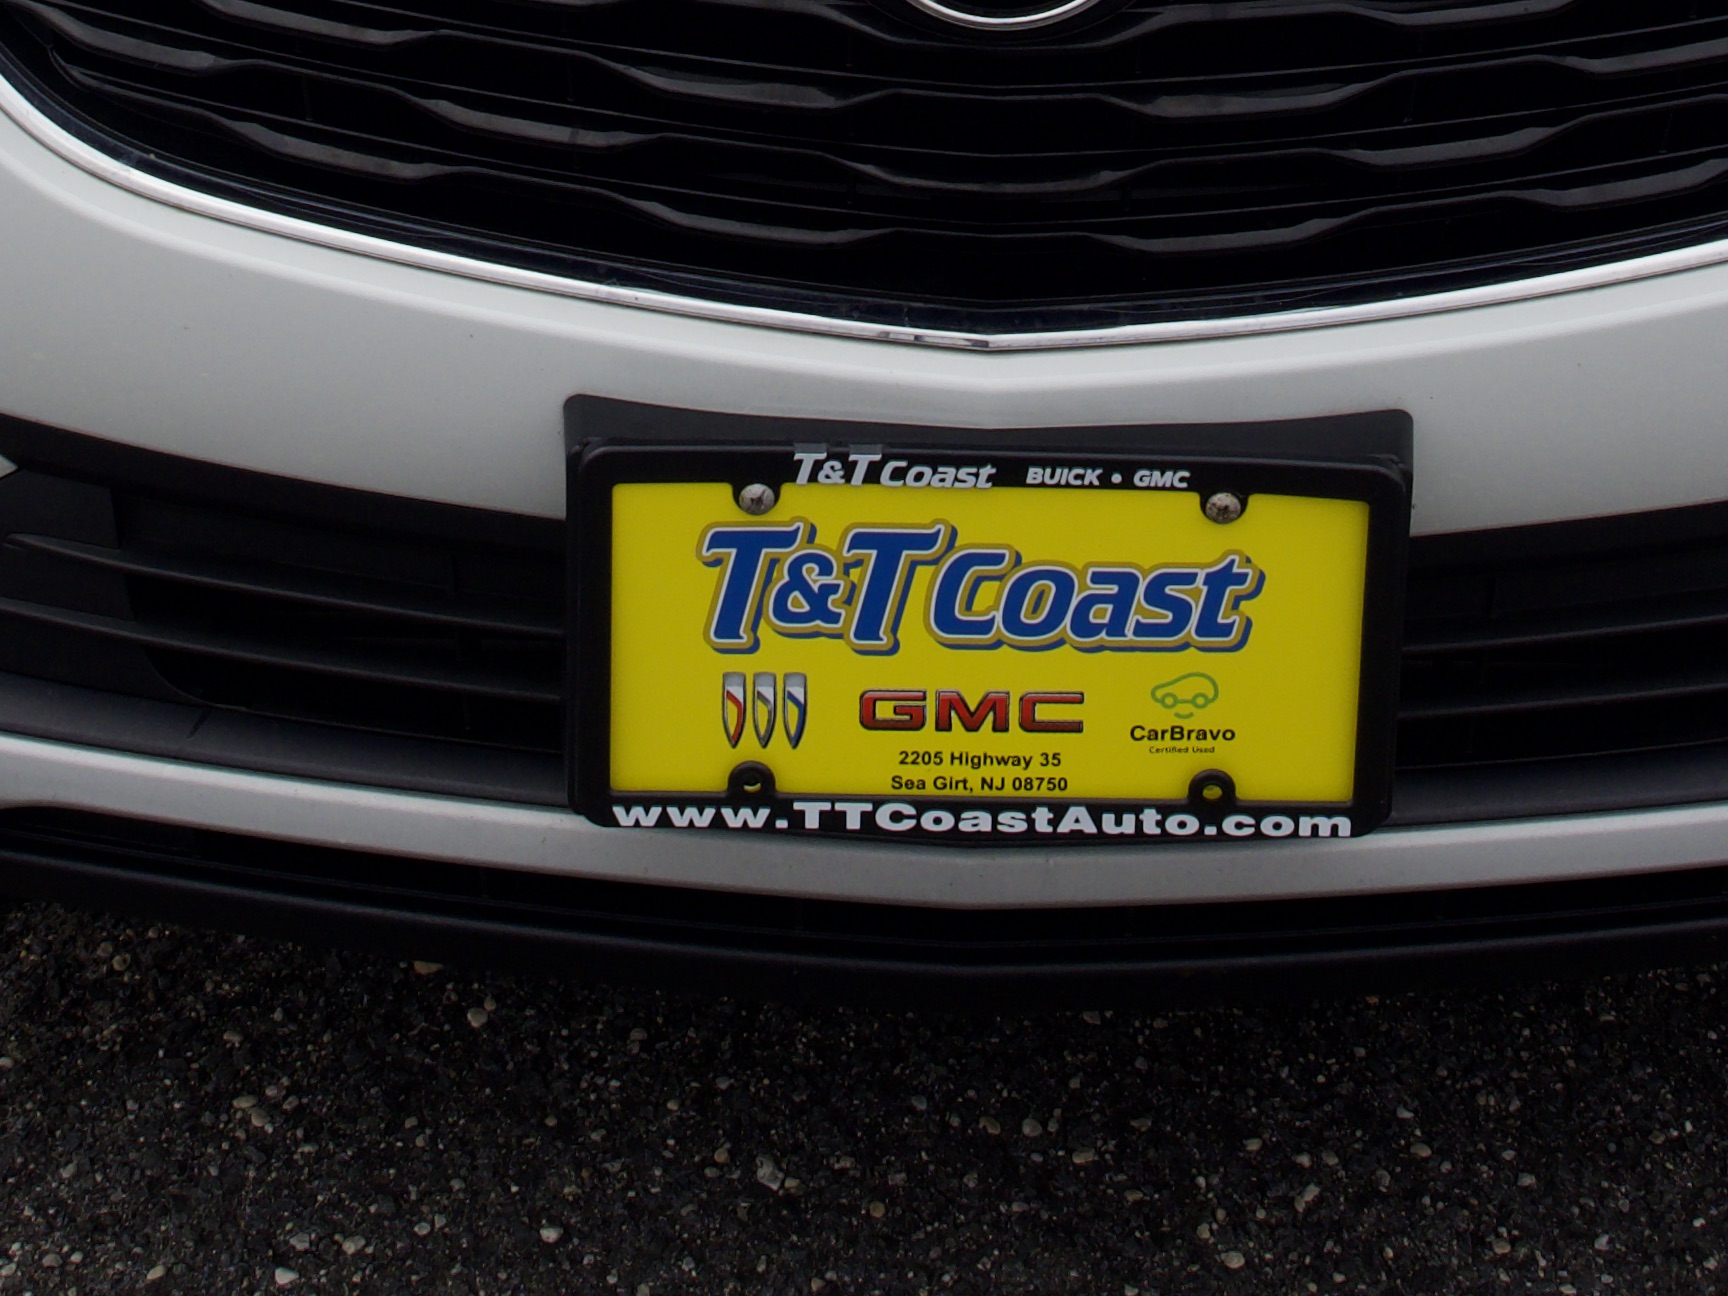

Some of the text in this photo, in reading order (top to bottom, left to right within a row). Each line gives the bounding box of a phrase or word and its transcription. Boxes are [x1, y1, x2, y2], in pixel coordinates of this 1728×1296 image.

[793, 452, 1191, 490] T&T Coast BUICK GMC
[696, 516, 1266, 655] T&T Coast
[859, 689, 1085, 734] GMC
[1129, 724, 1237, 742] CarBravo
[898, 751, 1062, 771] 2205 Highway 35
[1148, 746, 1216, 754] Certified Used
[891, 775, 1069, 794] Sea Girt, NJ 08750
[612, 801, 1354, 839] www.TTCoastAuto.com
